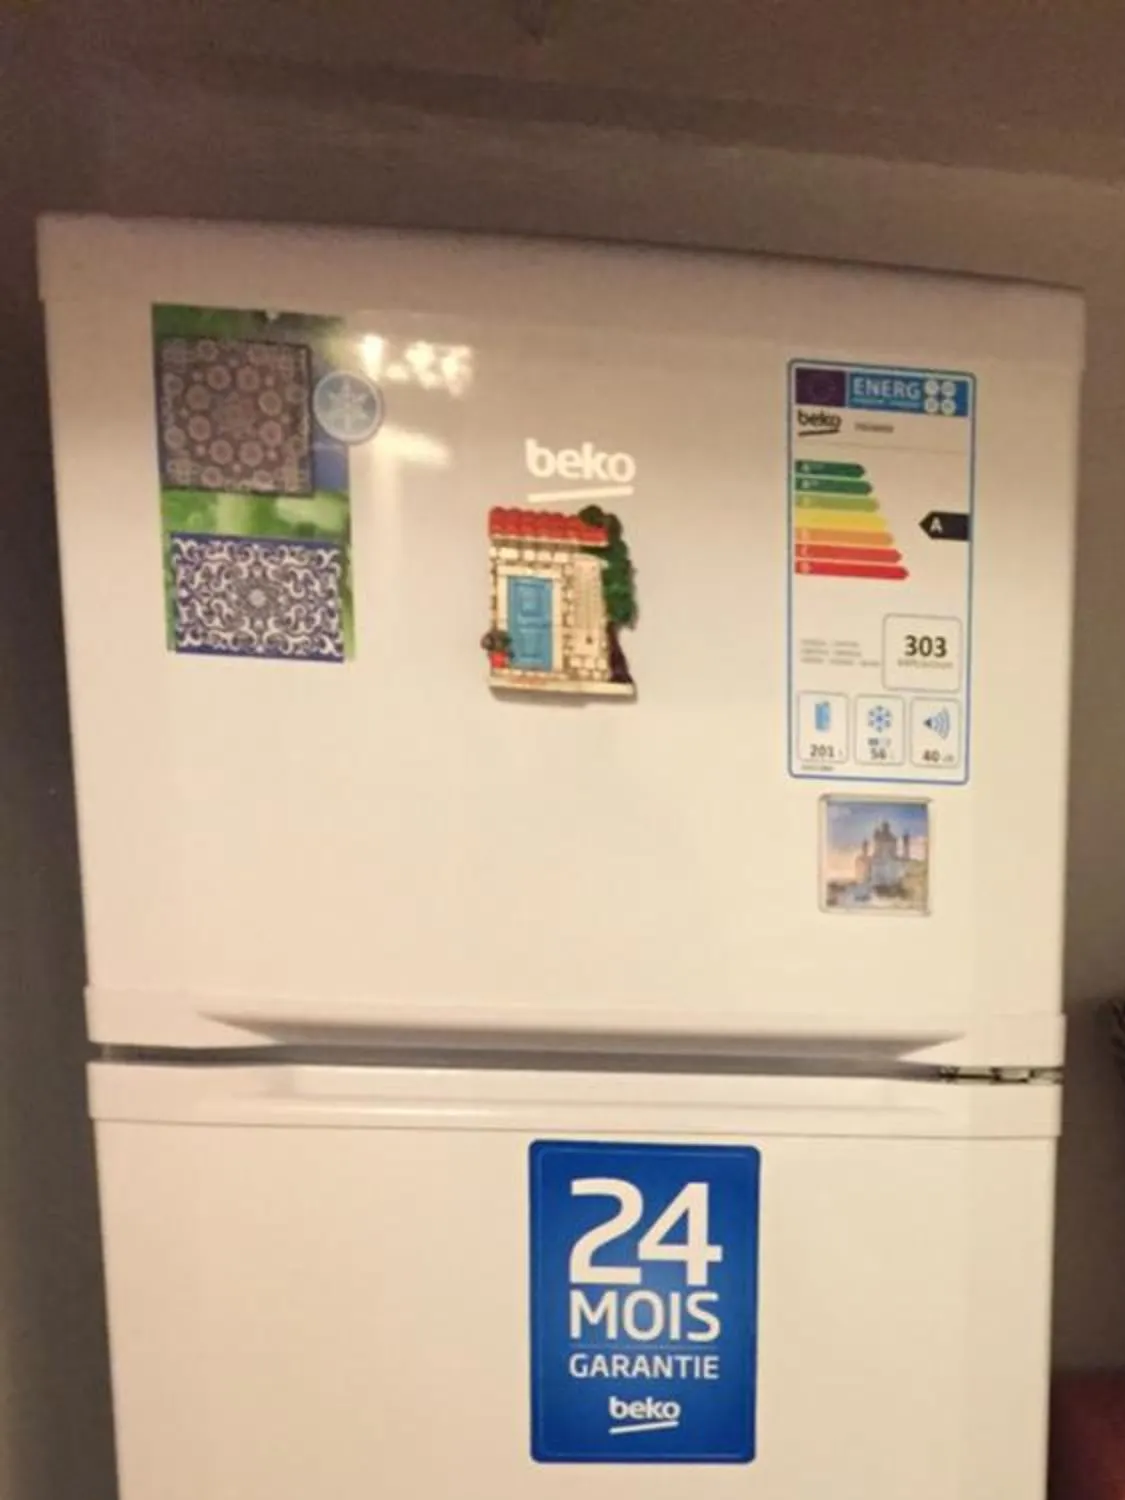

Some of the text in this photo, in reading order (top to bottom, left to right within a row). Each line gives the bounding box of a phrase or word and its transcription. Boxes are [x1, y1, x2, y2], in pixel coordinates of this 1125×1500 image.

[853, 377, 921, 399] ENERG
[797, 408, 842, 427] beko
[525, 438, 637, 483] beko
[930, 517, 943, 533] A
[904, 634, 948, 658] 303
[810, 744, 835, 757] 201
[569, 1177, 723, 1286] 24
[569, 1289, 721, 1342] MOIS
[569, 1353, 720, 1379] GARANTIE
[609, 1396, 681, 1420] beko
